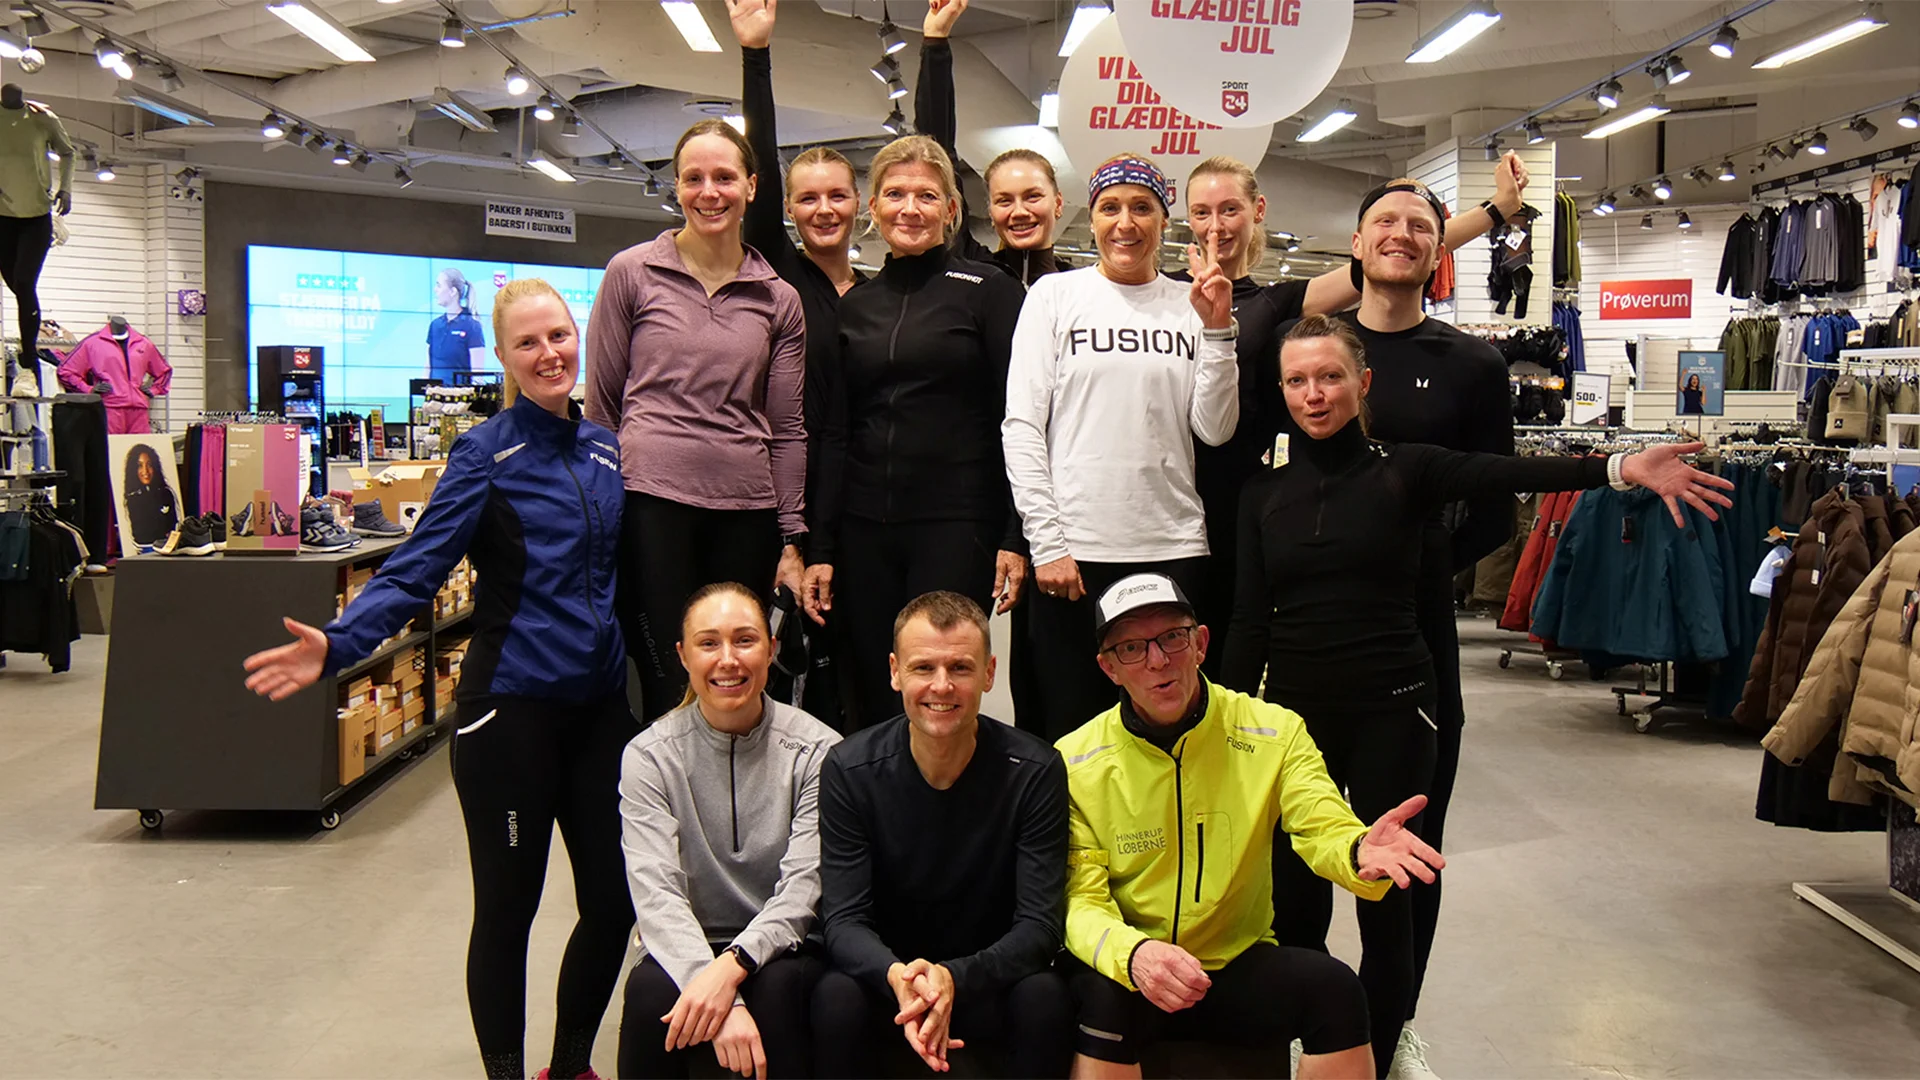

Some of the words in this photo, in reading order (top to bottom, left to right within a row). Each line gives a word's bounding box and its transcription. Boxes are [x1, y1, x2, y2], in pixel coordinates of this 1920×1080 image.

[1150, 0, 1300, 26] GLÆDELIG
[1220, 26, 1275, 54] JUL
[1099, 56, 1124, 80] VI
[1222, 81, 1249, 90] SPORT
[1225, 94, 1247, 111] 24
[1089, 106, 1223, 130] GLÆDEL
[1151, 132, 1200, 155] JUL
[488, 203, 521, 216] PAKKER
[524, 207, 564, 220] AFHENTES
[488, 218, 525, 230] BAGERST
[526, 221, 530, 230] I
[532, 222, 572, 235] BUTIKKEN
[1602, 291, 1688, 311] Prøverum
[1070, 327, 1195, 361] FUSION
[1226, 736, 1256, 754] FUSION
[507, 810, 518, 847] FUSION
[1116, 827, 1163, 842] HINNERUP
[1117, 836, 1167, 855] LØBERNE
